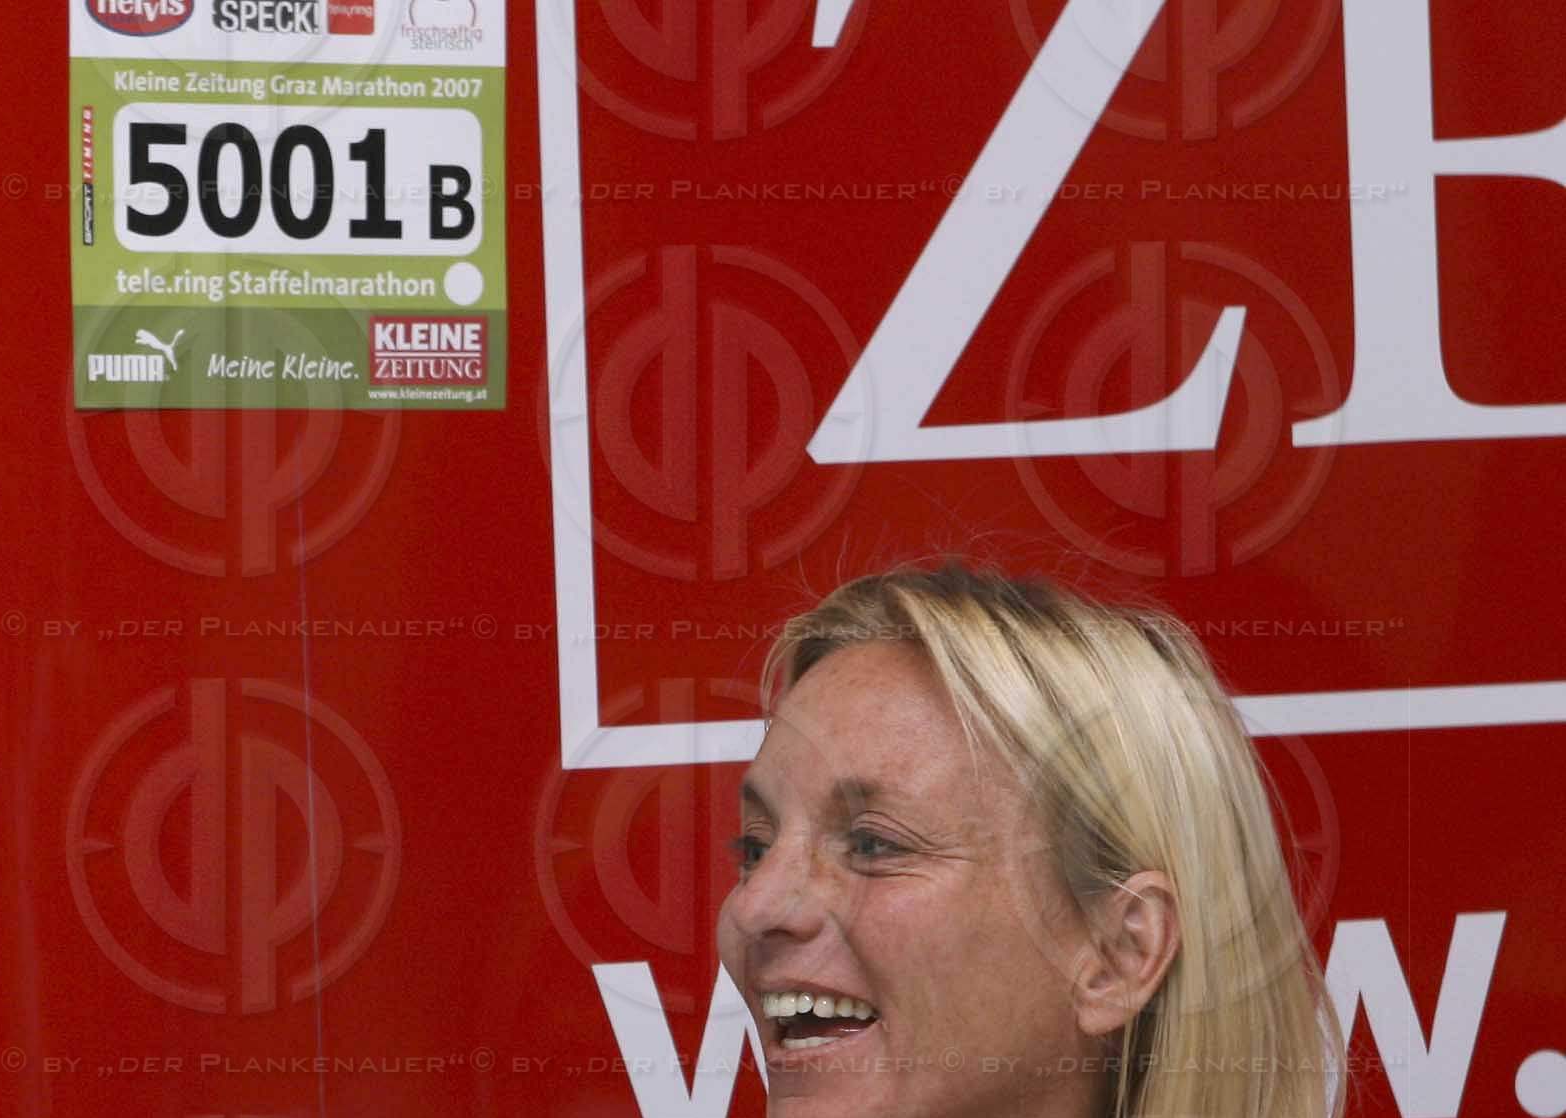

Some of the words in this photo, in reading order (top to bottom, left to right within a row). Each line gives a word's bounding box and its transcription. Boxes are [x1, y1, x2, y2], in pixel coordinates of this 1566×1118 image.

[114, 70, 180, 92] Kleine
[185, 72, 265, 100] Zeitung
[270, 75, 317, 95] Graz
[322, 76, 426, 97] Marathon
[431, 78, 483, 98] 2007
[126, 122, 403, 240] 5001
[428, 164, 476, 240] B
[116, 269, 224, 300] tele.ring
[228, 270, 435, 297] Staffelmarathon
[373, 322, 483, 352] KLEINE
[87, 354, 165, 382] PUMA
[207, 353, 276, 380] Meine
[281, 352, 360, 380] Kleine.
[373, 357, 483, 380] ZEITUNG
[367, 388, 488, 403] www.kleinezeitung.at
